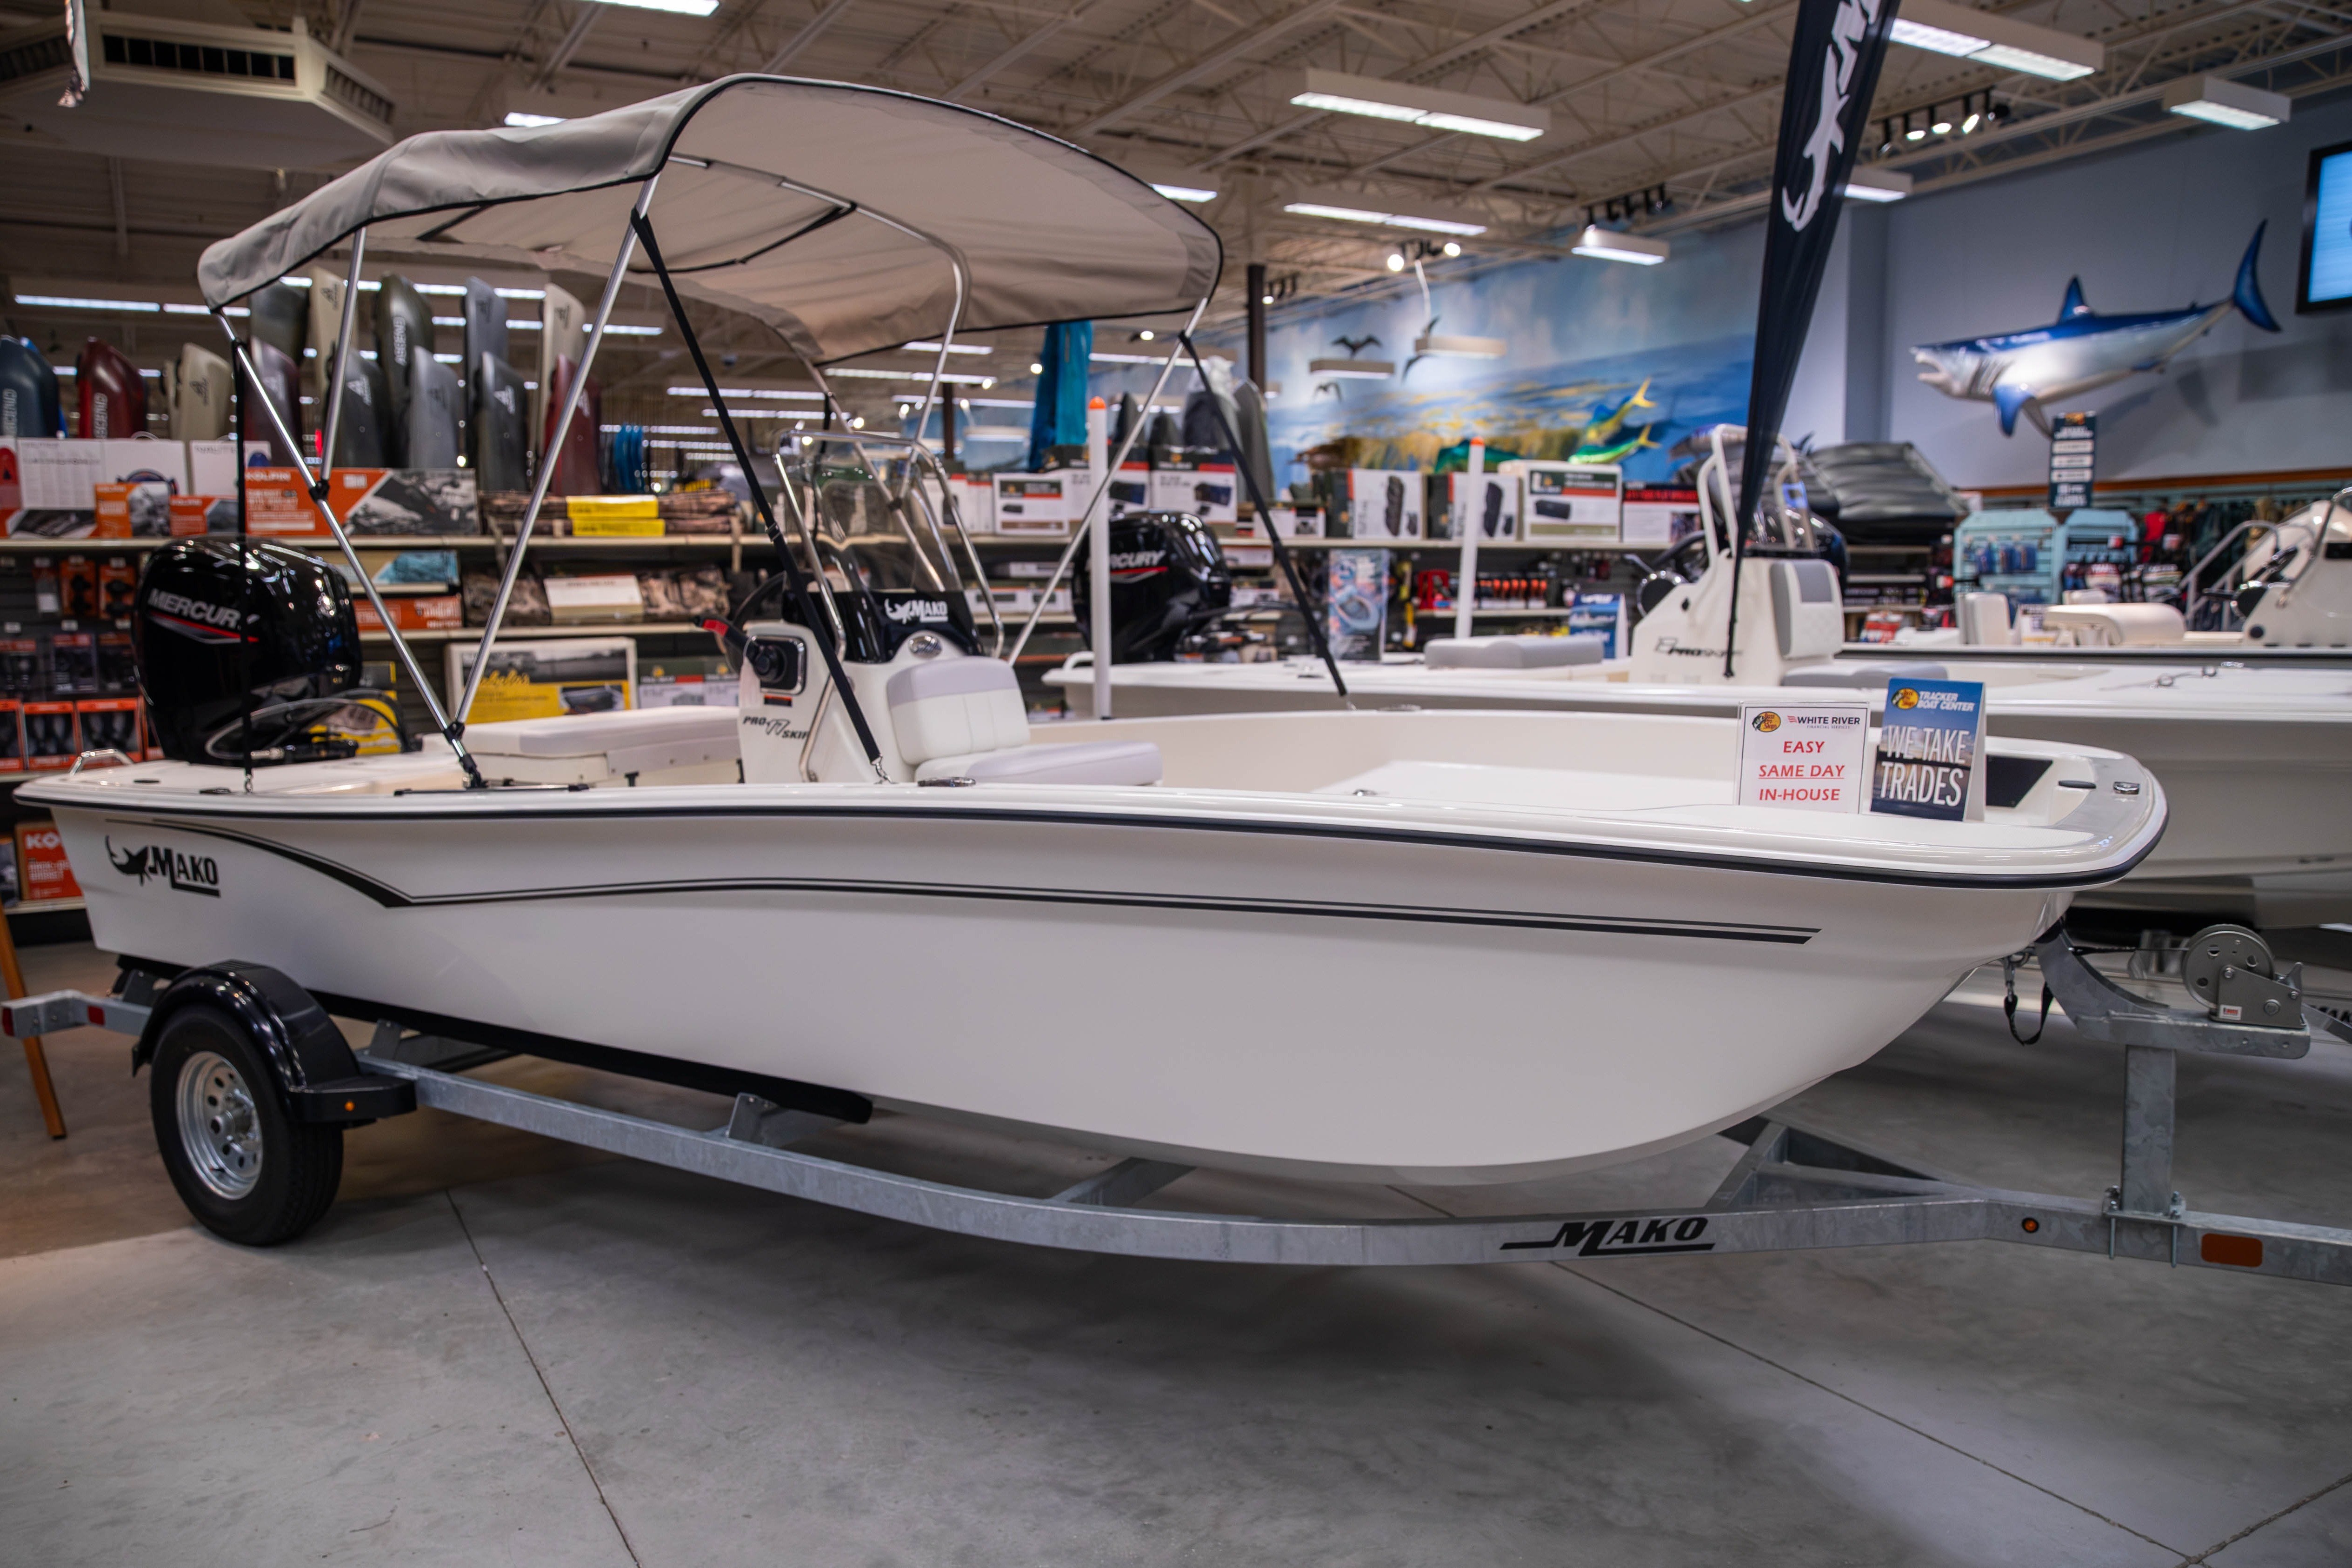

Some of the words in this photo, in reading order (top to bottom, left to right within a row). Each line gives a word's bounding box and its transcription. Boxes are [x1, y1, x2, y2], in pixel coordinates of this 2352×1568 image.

[909, 600, 948, 623] MAKO
[1919, 691, 1959, 701] TRACKER
[1917, 700, 1940, 709] BOAT
[1939, 701, 1975, 712] CENTER
[743, 715, 766, 726] PRO
[1783, 741, 1825, 753] EASY
[1887, 725, 1918, 759] WE
[1922, 727, 1970, 764] TAKE
[1759, 765, 1804, 777] SAME
[1811, 765, 1845, 777] DAY
[1880, 761, 1964, 807] TRADES
[1759, 789, 1840, 800] IN-HOUSE
[148, 845, 221, 898] MAKO
[1500, 1217, 1716, 1256] MAKO
